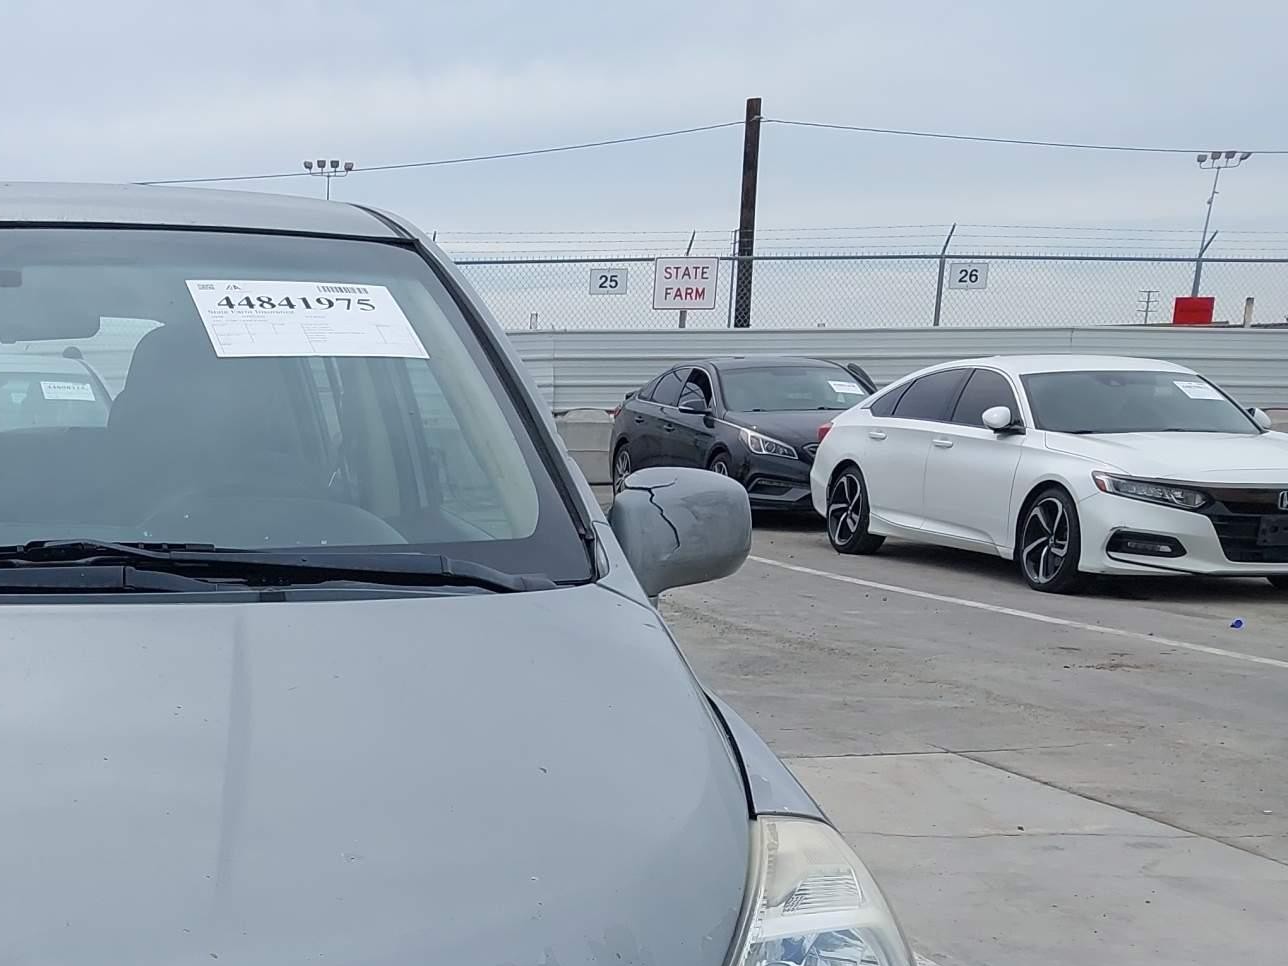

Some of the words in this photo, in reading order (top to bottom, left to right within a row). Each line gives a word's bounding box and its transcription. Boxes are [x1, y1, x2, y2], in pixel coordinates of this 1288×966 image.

[664, 266, 710, 280] STATE
[958, 268, 979, 284] 26
[598, 274, 619, 289] 25
[664, 287, 707, 301] FARM
[217, 295, 376, 312] 44841975
